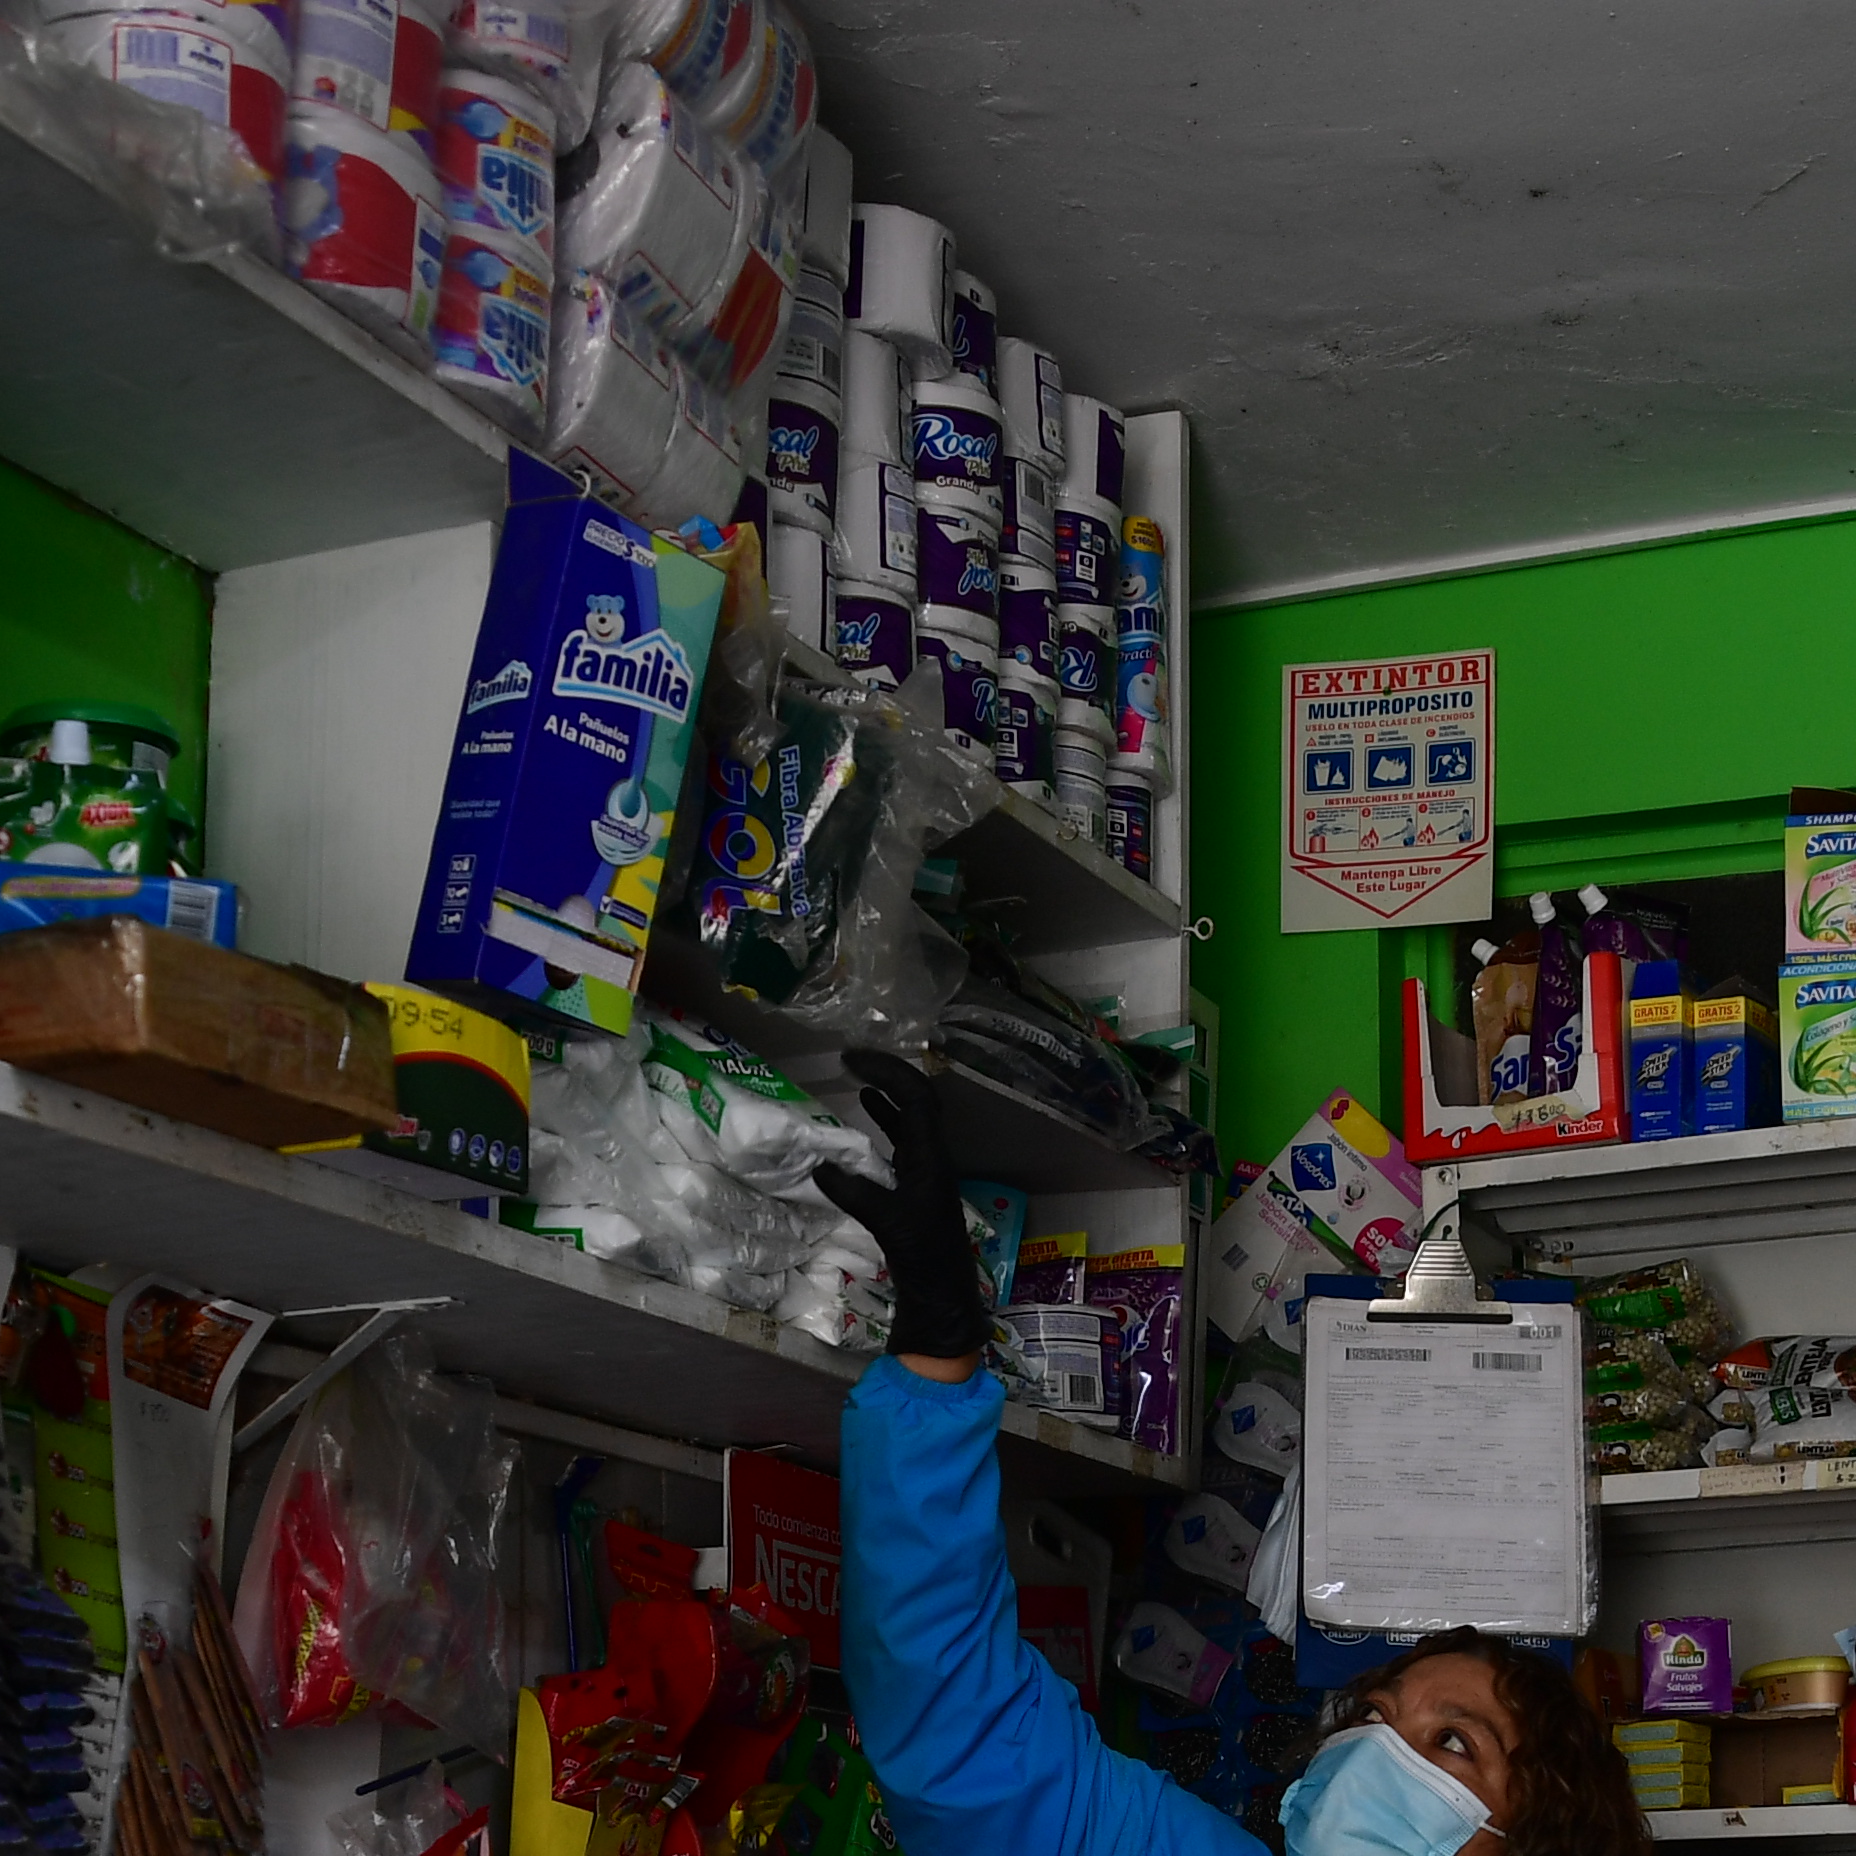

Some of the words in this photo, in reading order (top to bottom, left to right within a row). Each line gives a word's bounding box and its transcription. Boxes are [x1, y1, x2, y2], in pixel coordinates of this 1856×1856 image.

[913, 412, 999, 463] Rosal
[935, 474, 982, 494] Grande
[560, 635, 690, 711] familia
[1301, 660, 1480, 694] EXTINTOR
[467, 672, 530, 707] familia
[1308, 691, 1473, 720] MULTIPROPOSITO
[578, 711, 631, 747] Pañuelos
[1305, 723, 1335, 732] USELO
[1338, 721, 1350, 730] EN
[1353, 719, 1377, 730] TODA
[1379, 717, 1408, 728] CLASE
[1410, 715, 1423, 725] DE
[1424, 711, 1475, 723] INCENDIOS
[461, 742, 471, 756] A
[480, 740, 513, 755] mano
[543, 713, 559, 734] A
[559, 719, 579, 744] la
[578, 729, 628, 765] mano
[778, 743, 802, 810] Fibra
[1324, 793, 1399, 806] INSTRUCCIONES
[1402, 791, 1414, 800] DE
[1417, 788, 1455, 800] MANEJO
[80, 800, 138, 828] AXION
[781, 811, 811, 918] Abrasiva
[1341, 867, 1405, 881] Mantenga
[1409, 865, 1442, 877] Libre
[1356, 880, 1385, 893] Este
[1389, 879, 1427, 893] Lugar
[1634, 1004, 1669, 1019] GRATIS
[1671, 1004, 1678, 1016] 2
[1698, 1004, 1733, 1019] GRATIS
[1734, 1004, 1742, 1016] 2
[1805, 1020, 1842, 1043] Colágeno
[1491, 1051, 1530, 1100] San
[1556, 1121, 1603, 1136] Kinder
[1327, 1132, 1348, 1155] Jabón
[1291, 1146, 1334, 1189] Nosotras
[1255, 1191, 1288, 1224] Jabón
[1797, 1444, 1836, 1456] LENTEJA
[753, 1503, 780, 1528] Todo
[781, 1514, 830, 1543] comienza
[755, 1533, 841, 1618] NESCA
[1664, 1652, 1704, 1667] Hindú
[1666, 1682, 1705, 1694] Salvajes
[1670, 1671, 1699, 1683] Frutos
